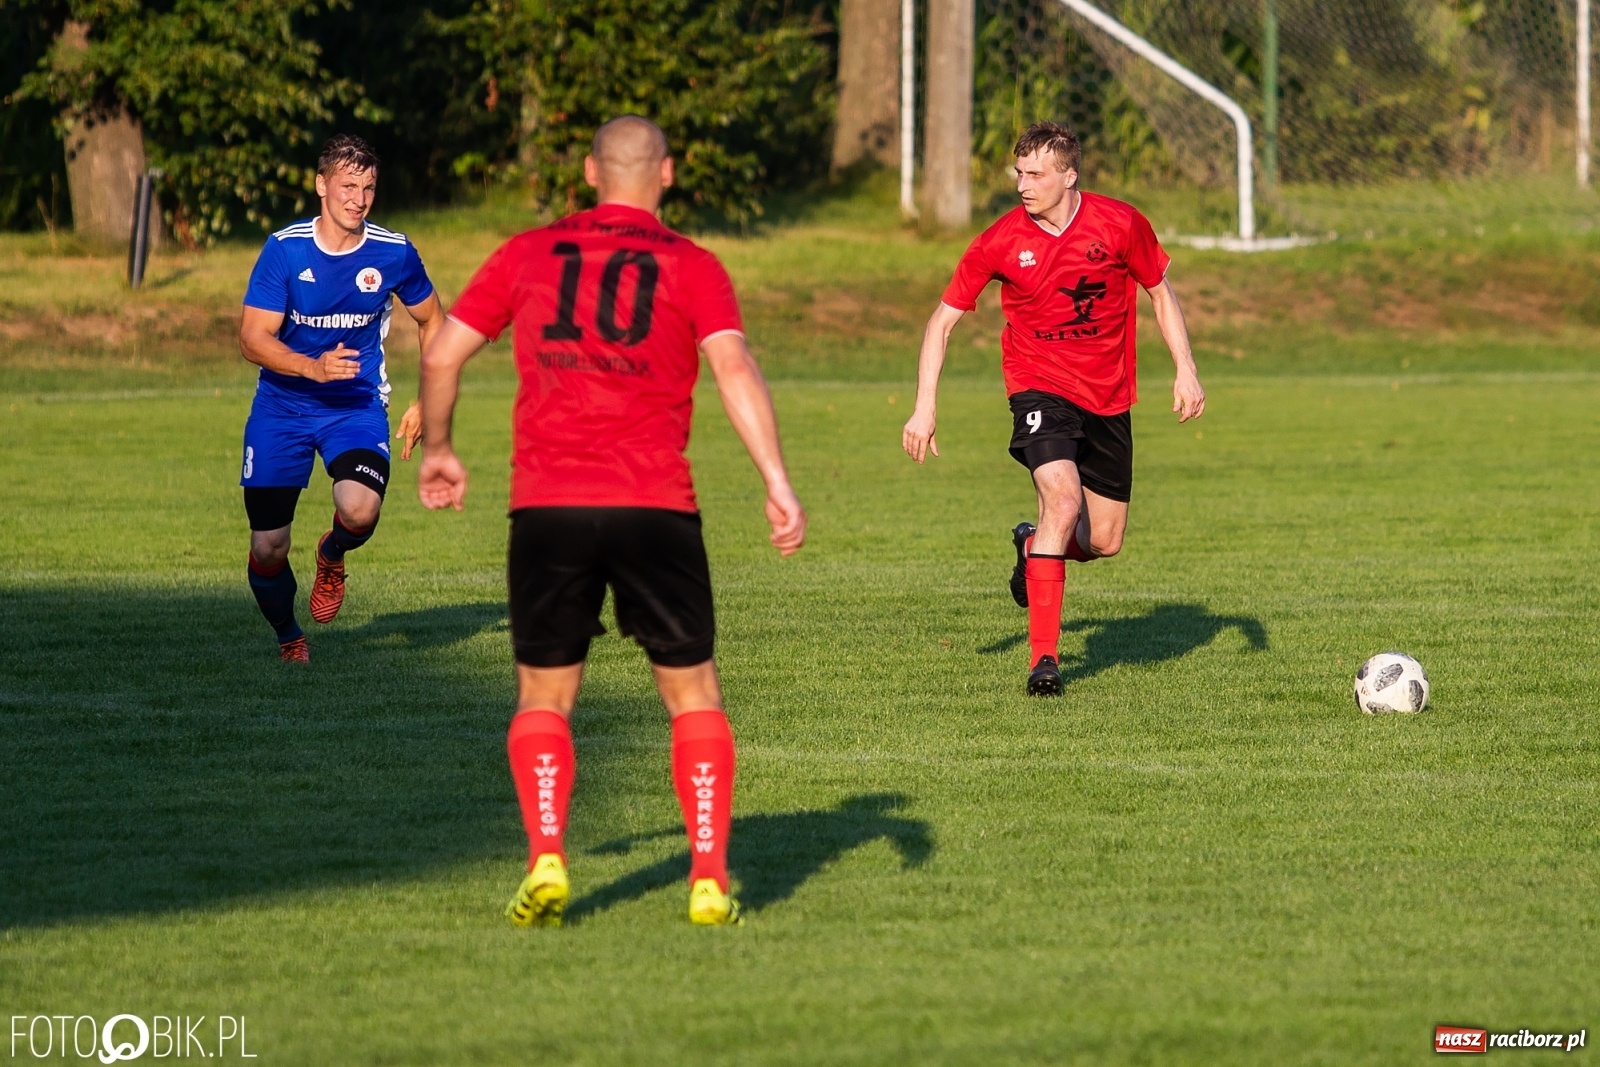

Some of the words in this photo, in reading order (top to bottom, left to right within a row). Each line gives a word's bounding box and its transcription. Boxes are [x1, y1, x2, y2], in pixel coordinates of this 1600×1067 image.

[541, 240, 661, 347] 10
[243, 446, 254, 479] 3
[1026, 410, 1042, 434] 9
[533, 752, 559, 837] TWORKOW
[691, 761, 717, 854] TWORKOW
